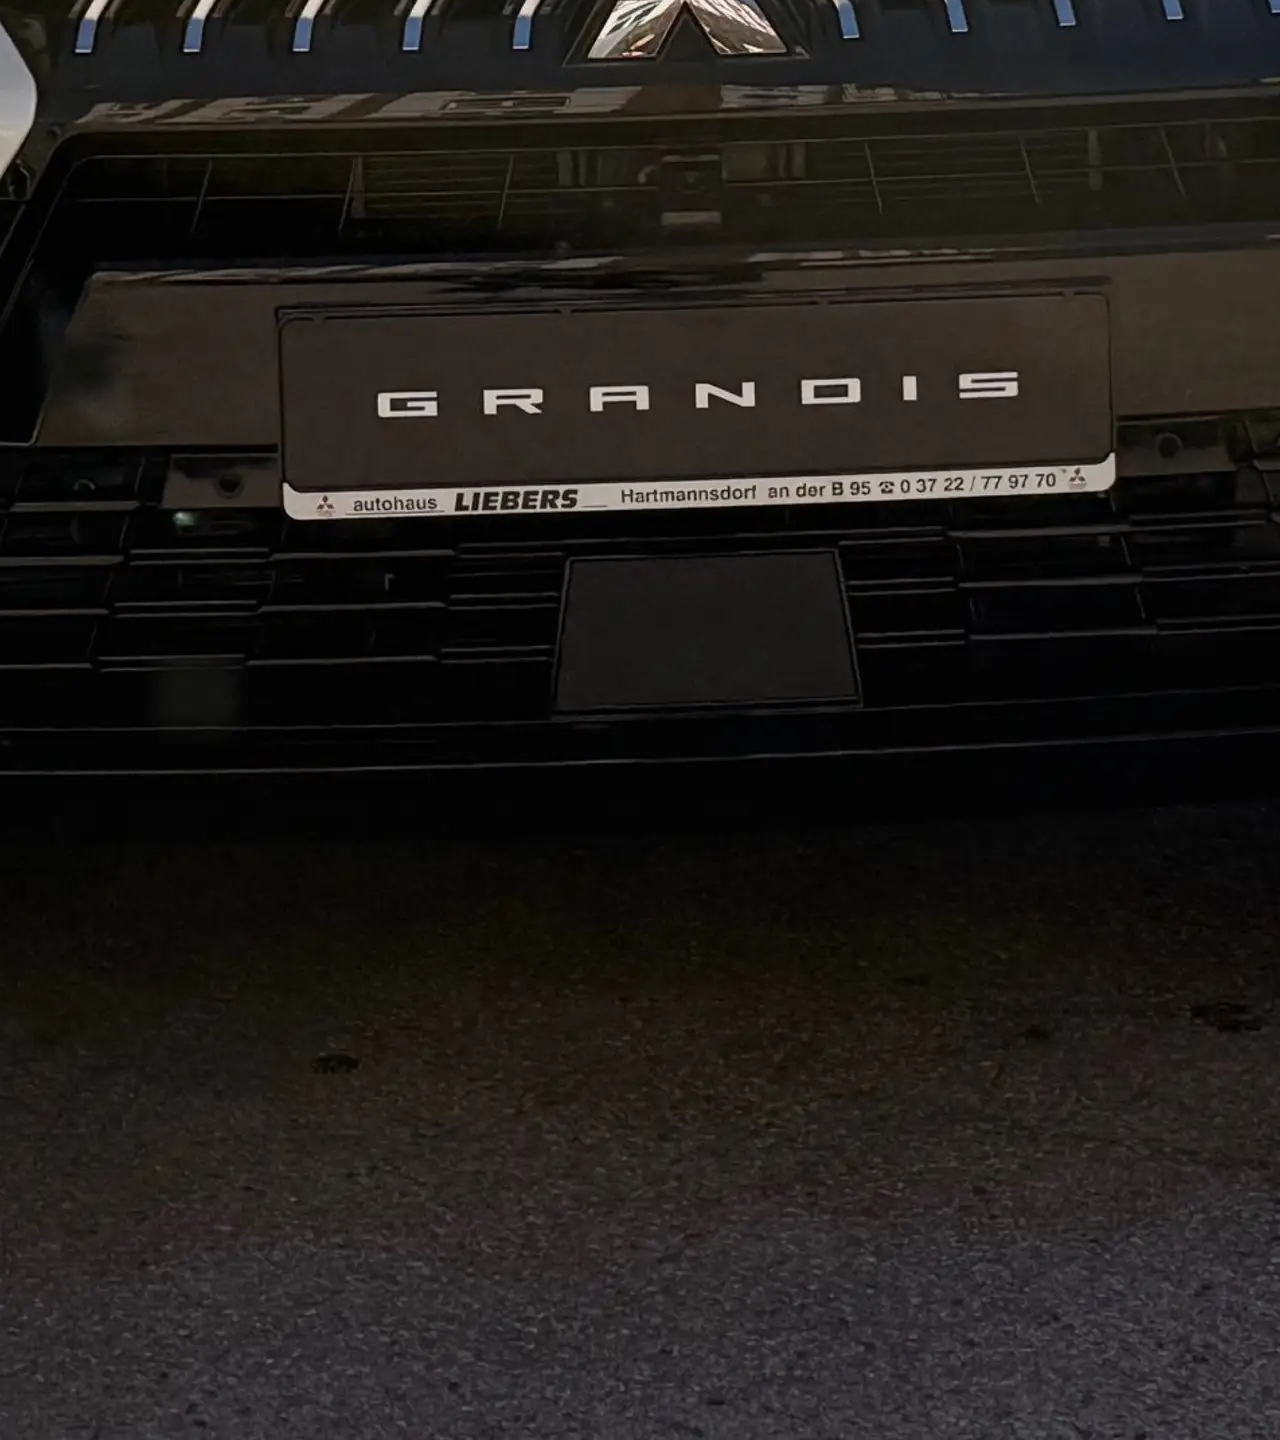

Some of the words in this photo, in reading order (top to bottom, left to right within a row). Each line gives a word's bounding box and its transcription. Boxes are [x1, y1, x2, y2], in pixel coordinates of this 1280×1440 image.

[377, 371, 1019, 418] GRANDIS
[353, 496, 438, 512] autohaus
[454, 488, 579, 513] LIEBERS
[621, 484, 757, 504] Hartmannsdorf
[767, 486, 790, 499] an
[795, 482, 826, 498] der
[831, 481, 844, 497] B
[849, 481, 871, 496] 95
[900, 479, 911, 494] 0
[915, 478, 938, 493] 37
[943, 476, 965, 492] 22
[980, 474, 1003, 490] 77
[1008, 474, 1029, 490] 97
[1035, 472, 1057, 488] 70
